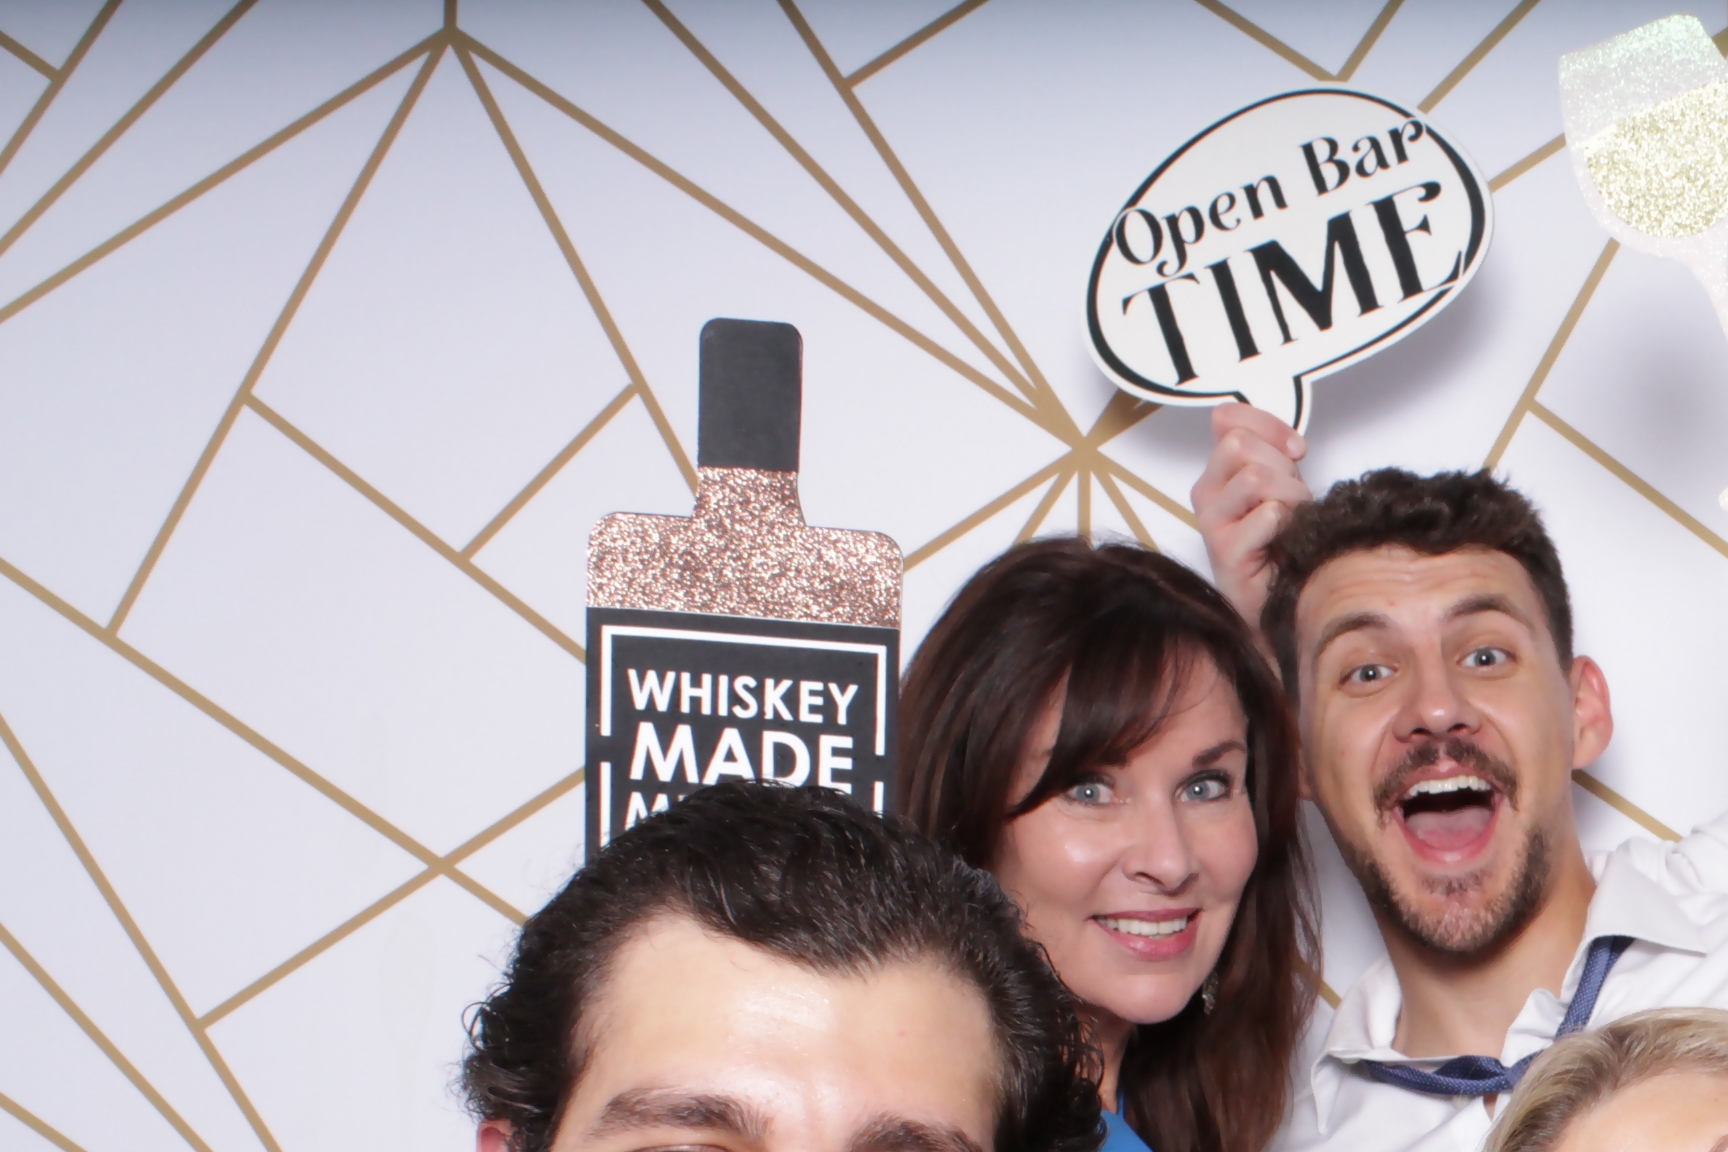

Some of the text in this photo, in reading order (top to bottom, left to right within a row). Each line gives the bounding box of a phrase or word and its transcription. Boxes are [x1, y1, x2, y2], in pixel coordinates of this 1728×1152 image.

[1114, 118, 1425, 278] Open Bar
[1121, 180, 1463, 386] TIME
[627, 667, 858, 725] WHISKEY
[629, 721, 853, 795] MADE
